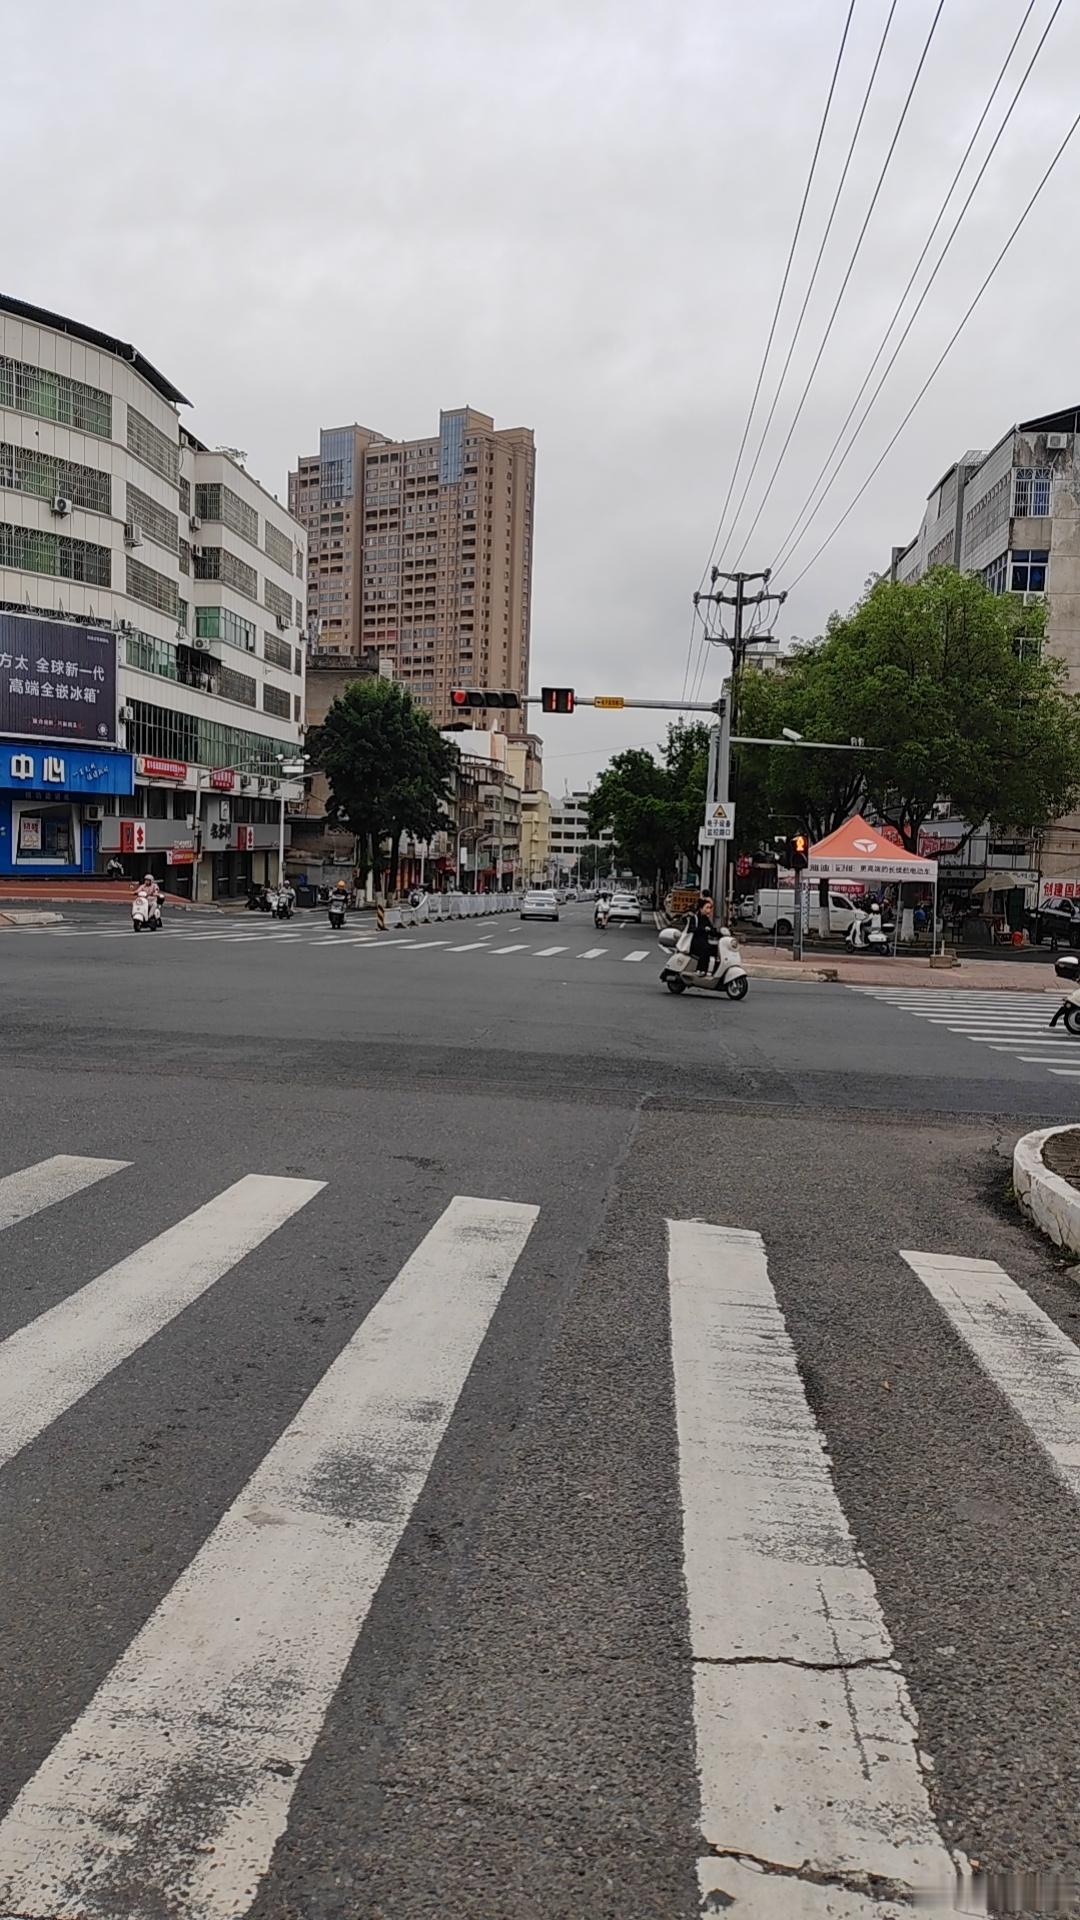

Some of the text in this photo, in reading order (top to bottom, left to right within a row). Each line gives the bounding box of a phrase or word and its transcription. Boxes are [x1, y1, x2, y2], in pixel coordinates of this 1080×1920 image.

[0, 651, 105, 682] 方太 全球新一代
[11, 753, 66, 783] 中心
[707, 819, 731, 828] 电子设备
[707, 828, 731, 837] 监控路口
